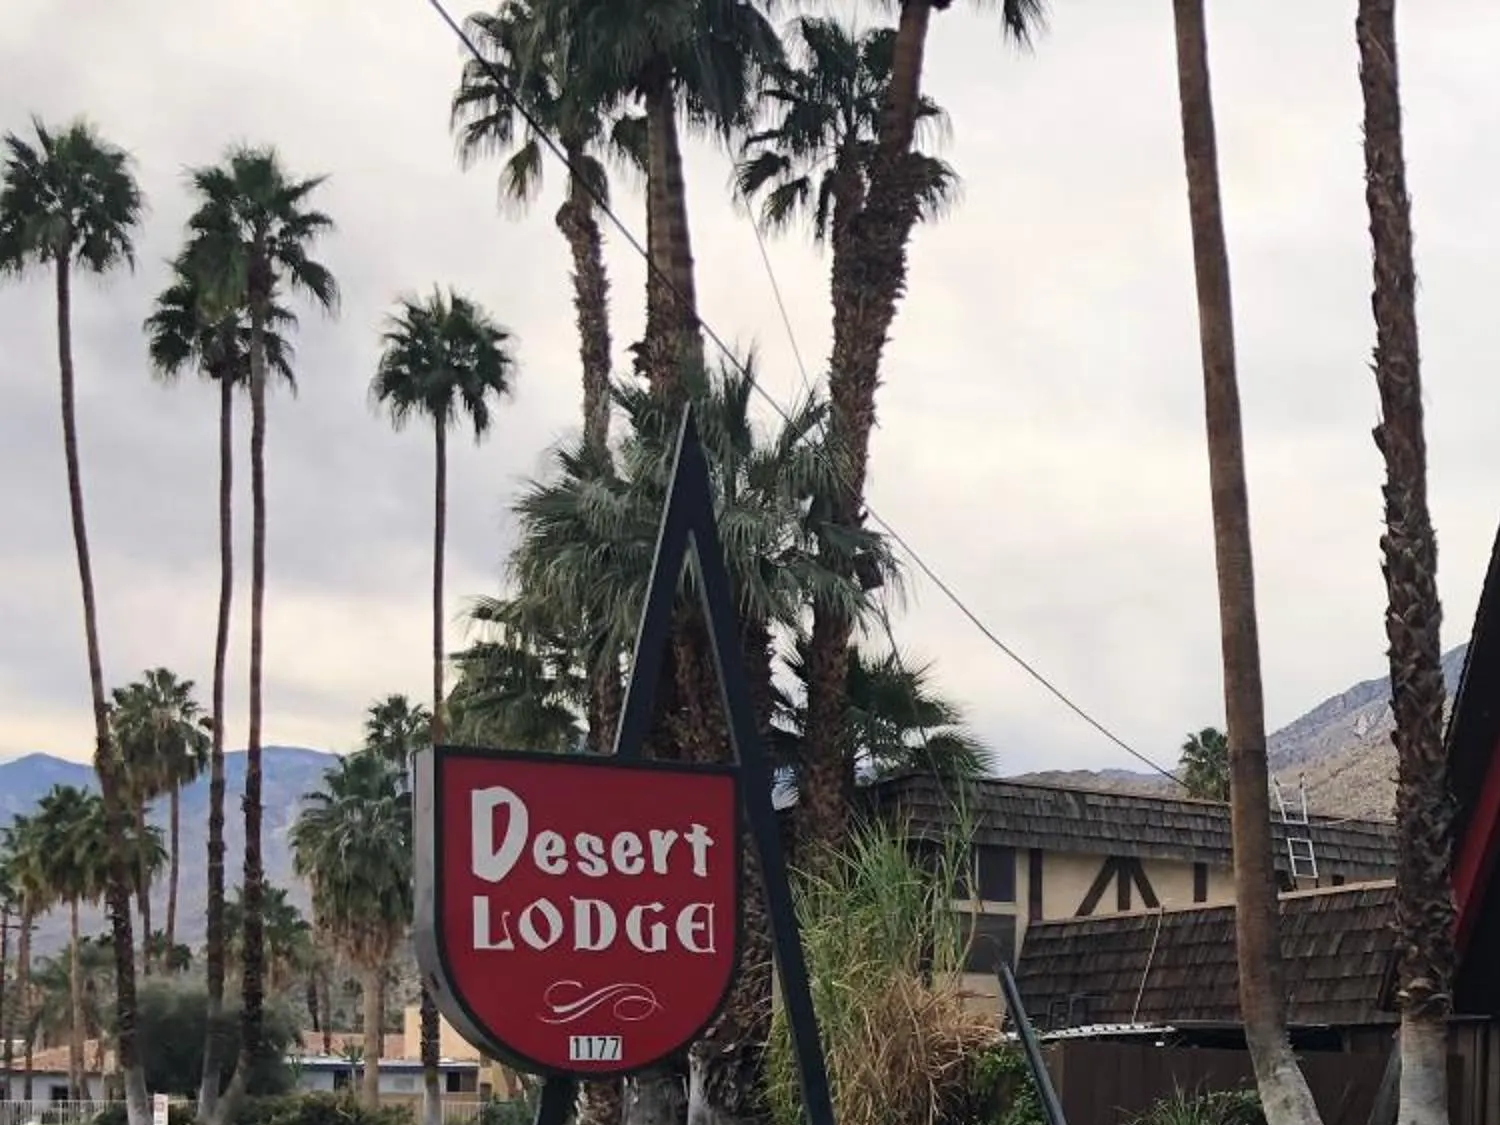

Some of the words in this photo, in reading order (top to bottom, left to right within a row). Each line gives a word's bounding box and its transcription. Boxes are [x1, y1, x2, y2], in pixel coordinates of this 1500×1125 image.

[471, 786, 714, 883] Desert
[472, 896, 716, 953] LODGE
[573, 1037, 620, 1059] 1177
